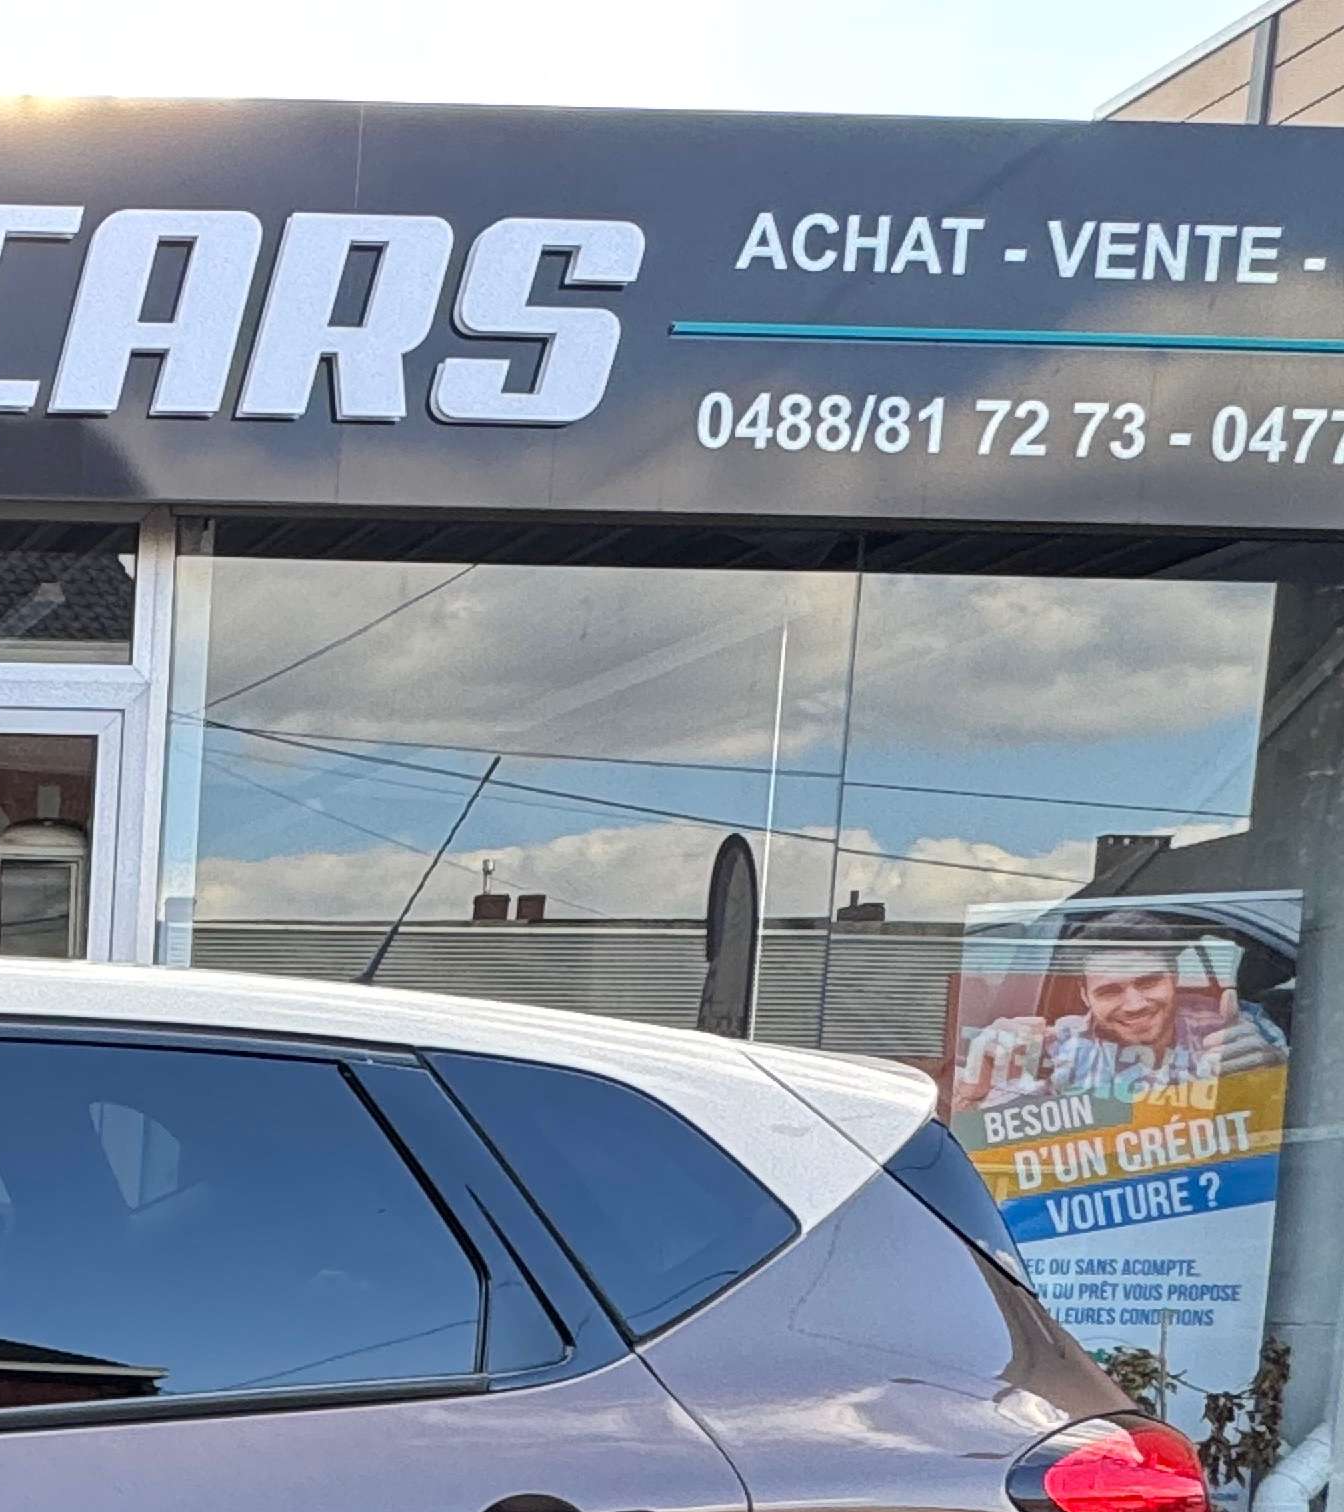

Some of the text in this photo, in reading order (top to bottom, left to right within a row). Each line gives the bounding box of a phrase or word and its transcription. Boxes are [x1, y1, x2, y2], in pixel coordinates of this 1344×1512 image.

[736, 211, 985, 276] ACHAT
[1047, 219, 1283, 285] VENTE
[697, 392, 946, 454] 0488/81
[974, 399, 1050, 456] 72
[1072, 400, 1147, 461] 73
[984, 1094, 1095, 1144] BESOIN
[1015, 1110, 1252, 1190] D'UN CRÉDIT
[1046, 1171, 1220, 1233] VOITURE ?
[1050, 1259, 1070, 1275] OU
[1075, 1259, 1117, 1275] SANS
[1121, 1259, 1200, 1277] ACOMPTE.
[1079, 1281, 1119, 1300] PRÊT
[1122, 1284, 1163, 1301] VOUS
[1167, 1284, 1242, 1301] PROPOSE
[1119, 1308, 1214, 1326] CONDITIONS
